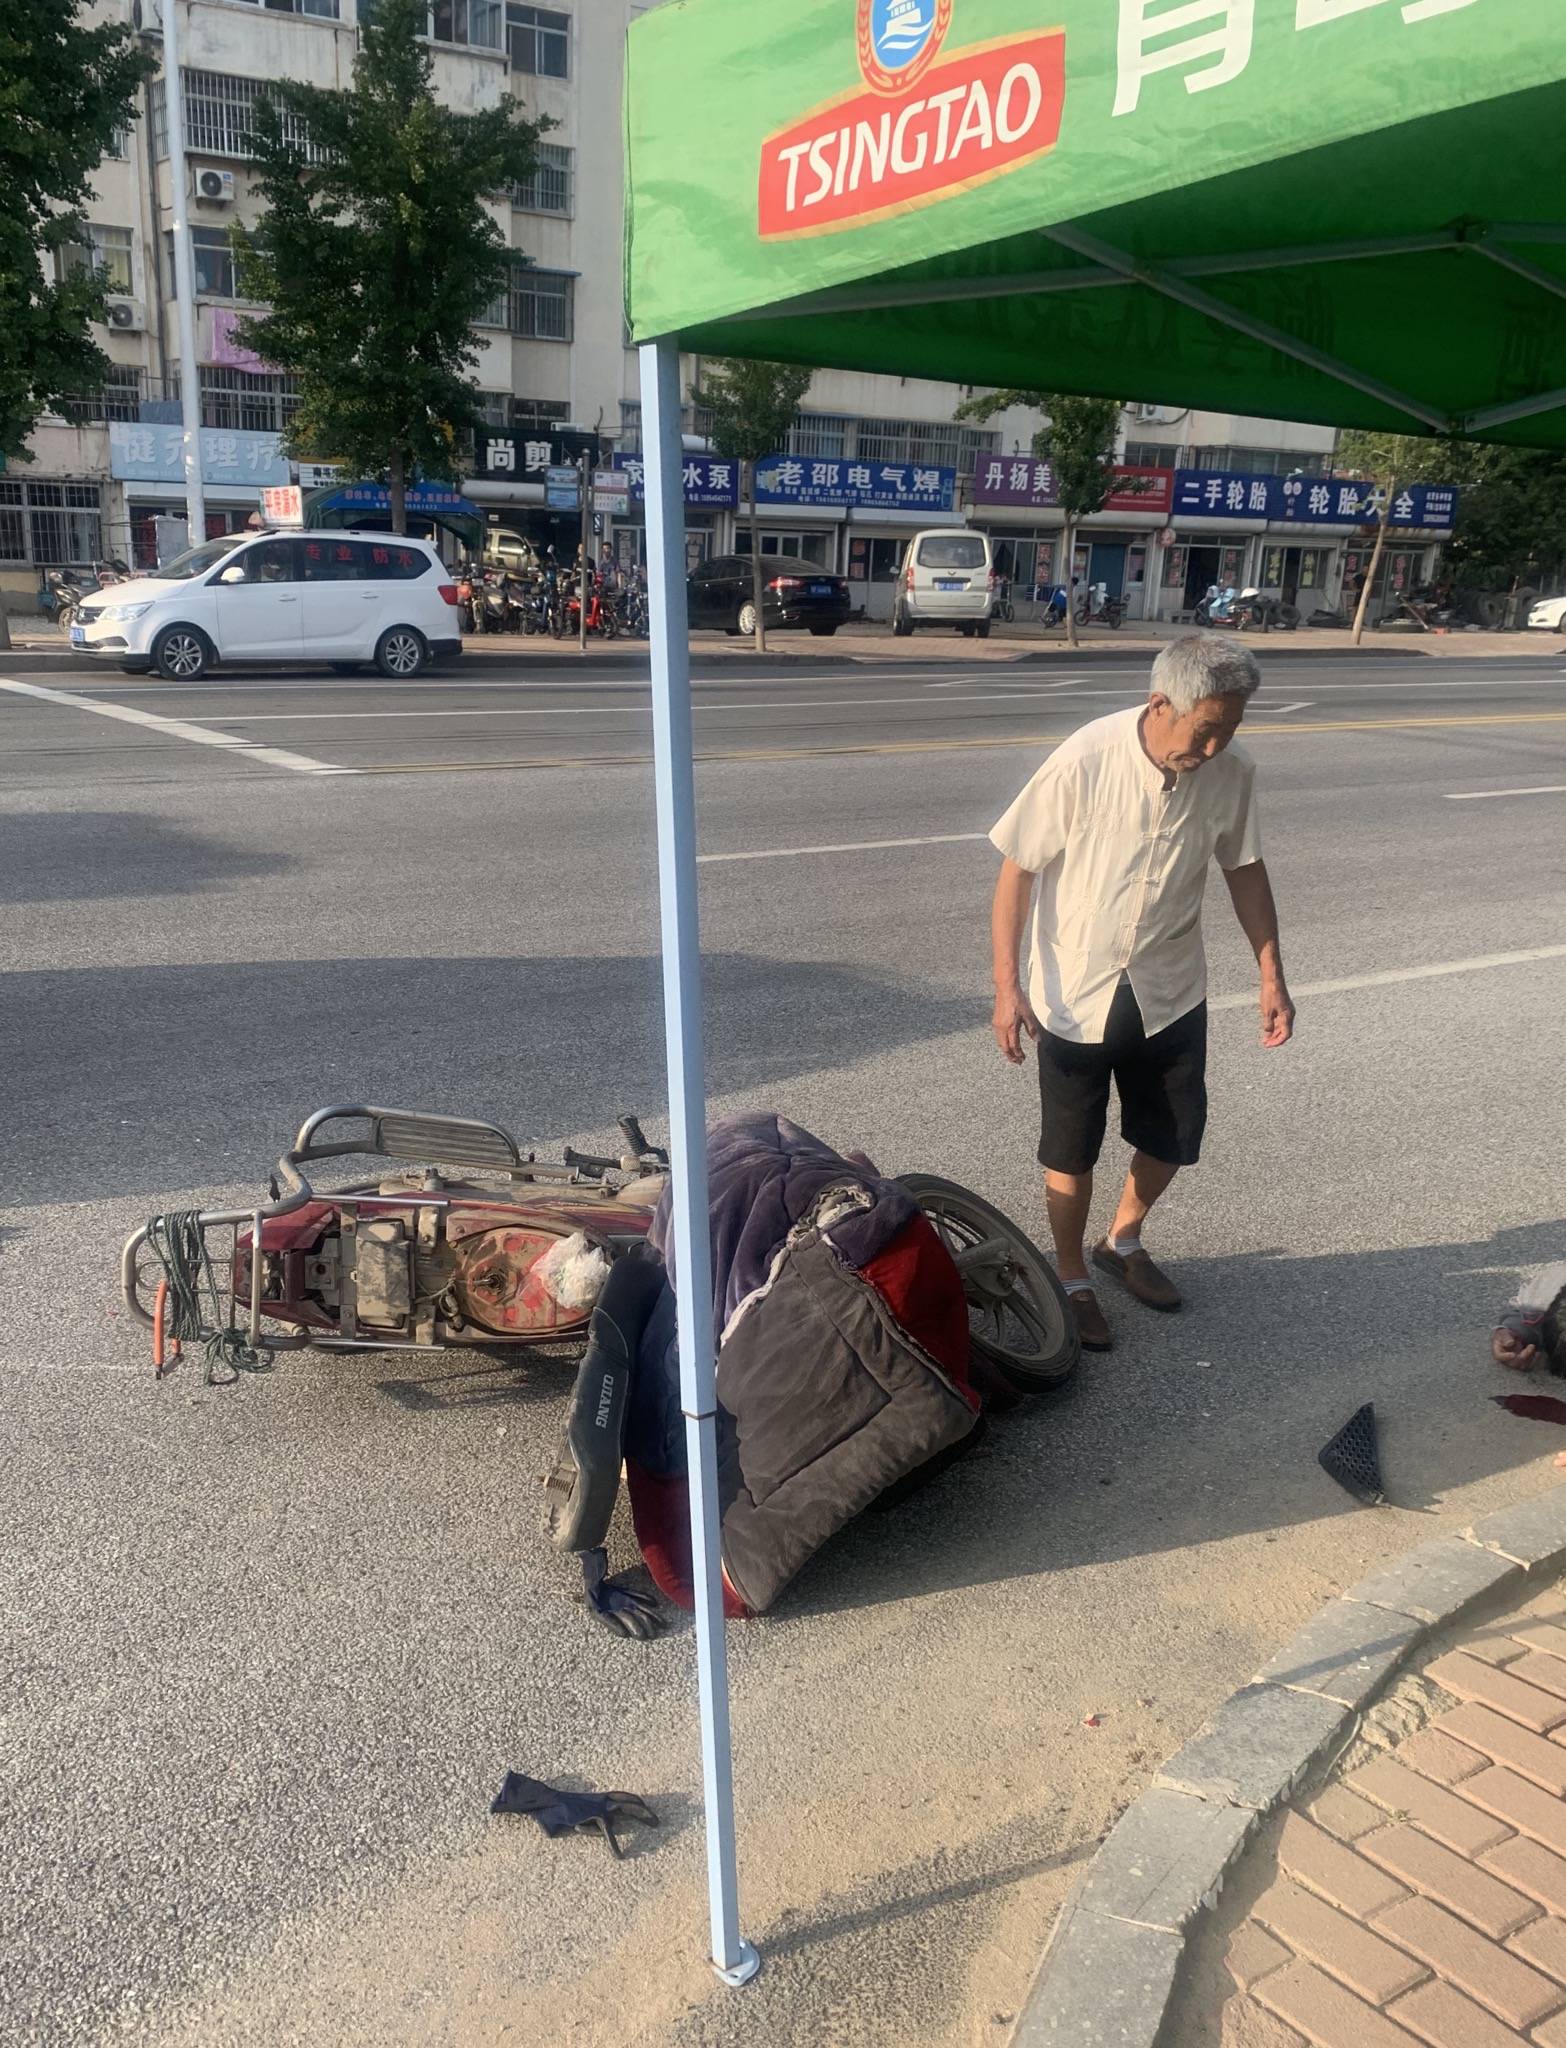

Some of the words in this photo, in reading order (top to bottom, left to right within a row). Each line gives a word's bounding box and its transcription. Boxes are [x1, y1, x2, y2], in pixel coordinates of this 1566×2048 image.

[778, 63, 1041, 212] TSINGTAO
[487, 439, 552, 472] 尚剪
[622, 460, 732, 489] 家水泵
[776, 460, 940, 493] 老邵电气焊
[1181, 479, 1268, 511] 二手轮胎
[1308, 485, 1414, 519] 轮胎大全
[307, 544, 413, 567] 专业防水
